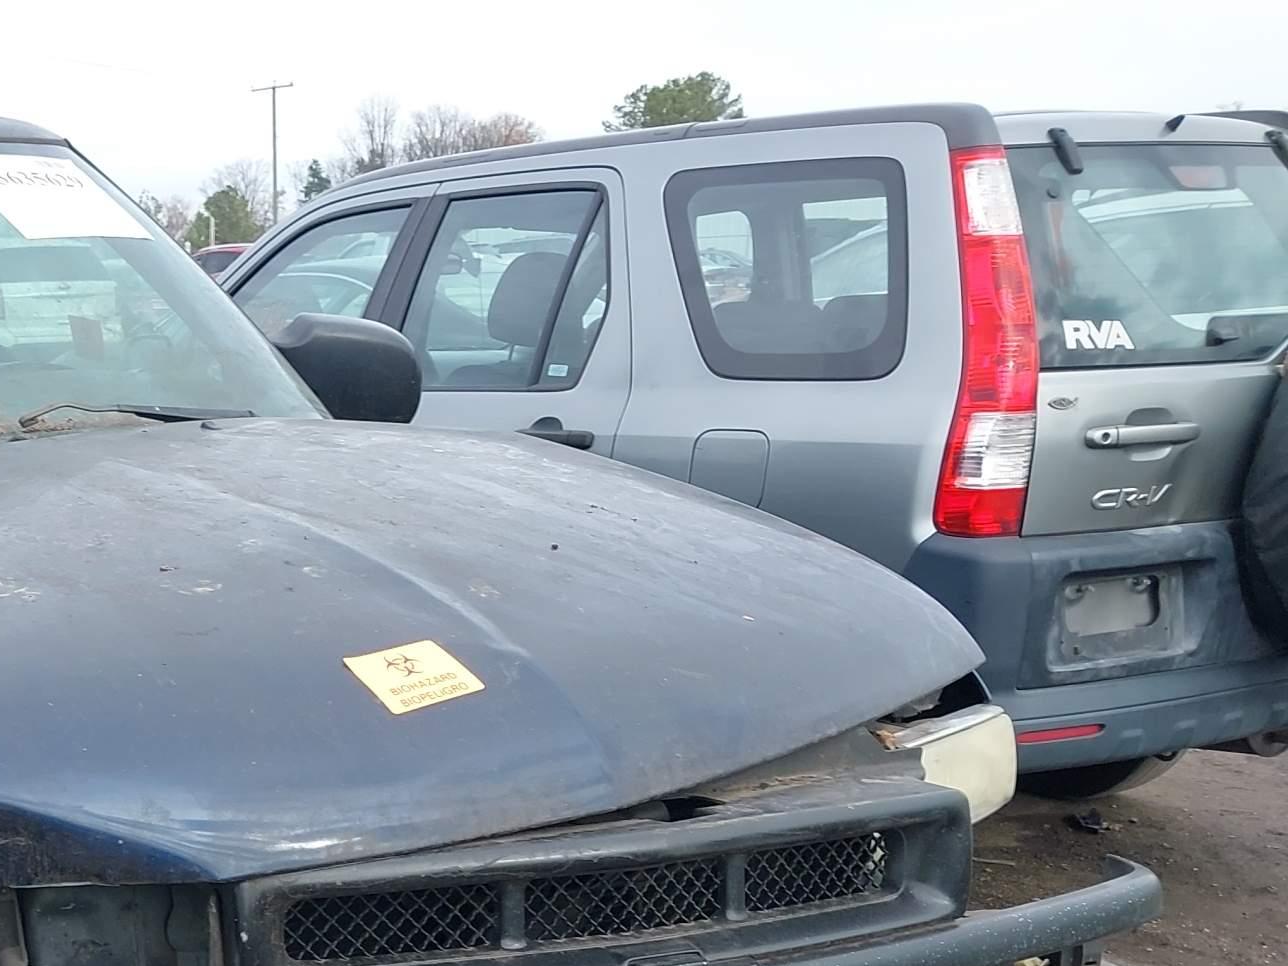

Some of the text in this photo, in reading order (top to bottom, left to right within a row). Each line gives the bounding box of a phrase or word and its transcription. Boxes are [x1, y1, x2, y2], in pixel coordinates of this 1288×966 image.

[1061, 319, 1136, 350] RVA
[1090, 483, 1173, 510] CR-V
[389, 672, 458, 696] BIOHAZARD
[400, 682, 470, 707] BIOPELIGRO
